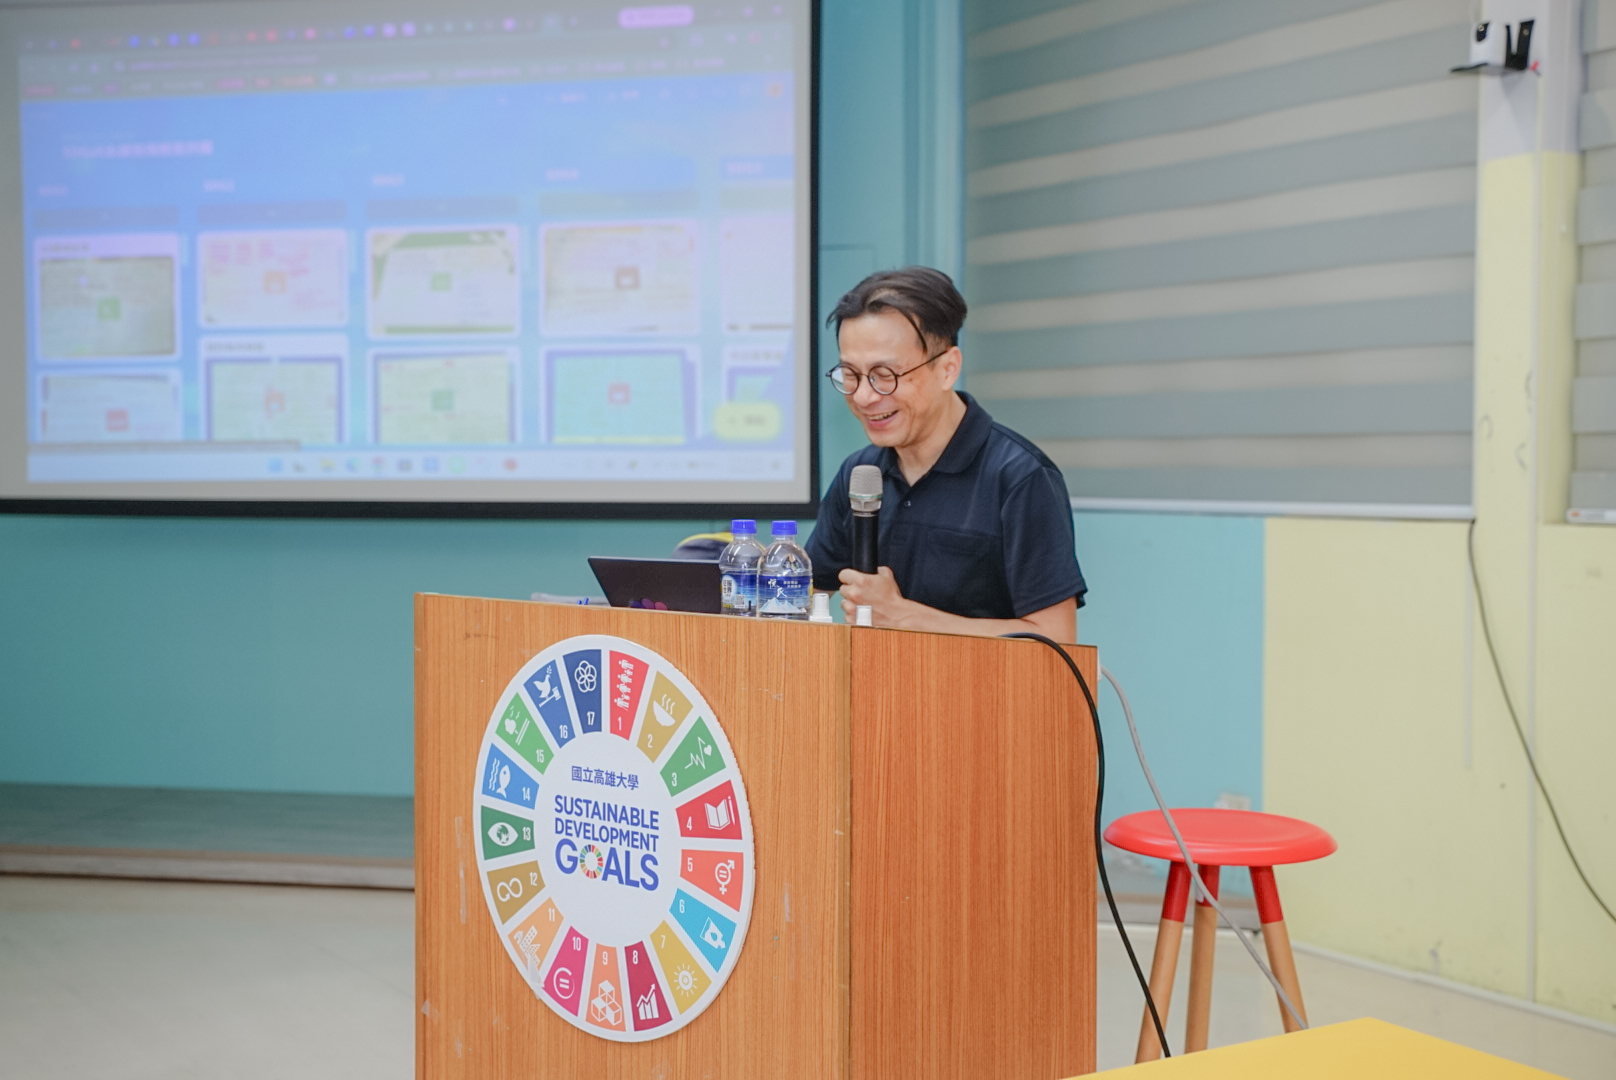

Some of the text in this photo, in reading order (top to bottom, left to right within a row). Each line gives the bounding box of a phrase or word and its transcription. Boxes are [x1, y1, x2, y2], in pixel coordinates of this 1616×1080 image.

[587, 711, 596, 726] 17
[617, 716, 622, 731] 1
[559, 724, 568, 739] 16
[647, 733, 653, 749] 2
[536, 749, 545, 764] 15
[571, 765, 639, 790] 國立高雄大學
[671, 772, 678, 787] 3
[522, 786, 531, 801] 14
[554, 794, 659, 830] SUSTAINABLE
[686, 816, 693, 831] 4
[522, 826, 531, 841] 13
[554, 817, 659, 852] DEVELOPMENT
[555, 838, 659, 891] GOALS
[687, 857, 694, 872] 5
[529, 872, 538, 887] 12
[679, 898, 685, 914] 6
[548, 907, 556, 922] 11
[572, 936, 582, 951] 10
[661, 935, 667, 949] 7
[602, 951, 608, 966] 9
[632, 949, 639, 965] 8
